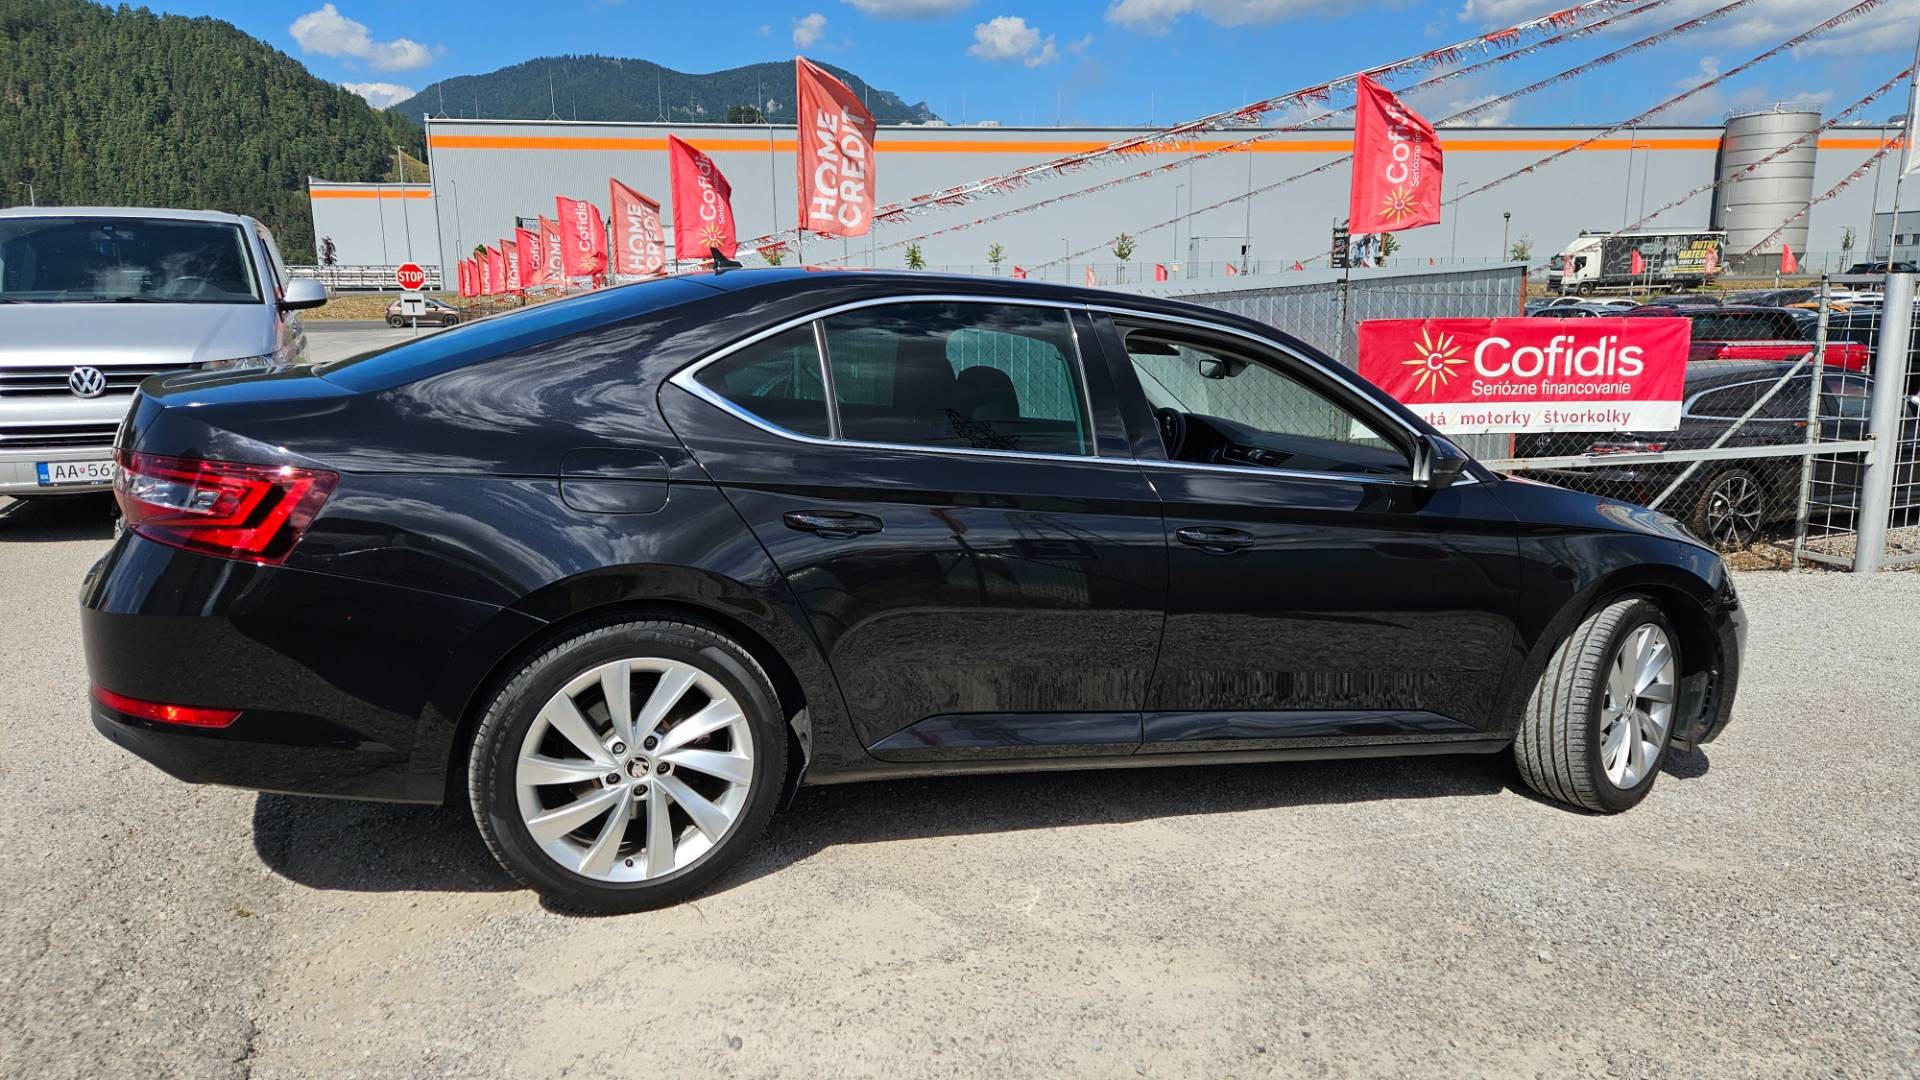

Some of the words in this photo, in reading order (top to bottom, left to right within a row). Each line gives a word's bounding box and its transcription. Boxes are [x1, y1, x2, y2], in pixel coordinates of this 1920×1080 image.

[811, 110, 838, 220] HOME
[838, 105, 866, 228] CREDIT
[628, 204, 645, 269] HOME
[398, 271, 423, 282] STOP
[1474, 336, 1644, 377] Cofidis
[1471, 380, 1537, 396] Seriózne
[1541, 378, 1632, 395] financovanie
[1460, 411, 1530, 428] motorky
[1544, 409, 1631, 427] štvorkolky
[55, 464, 79, 479] AA
